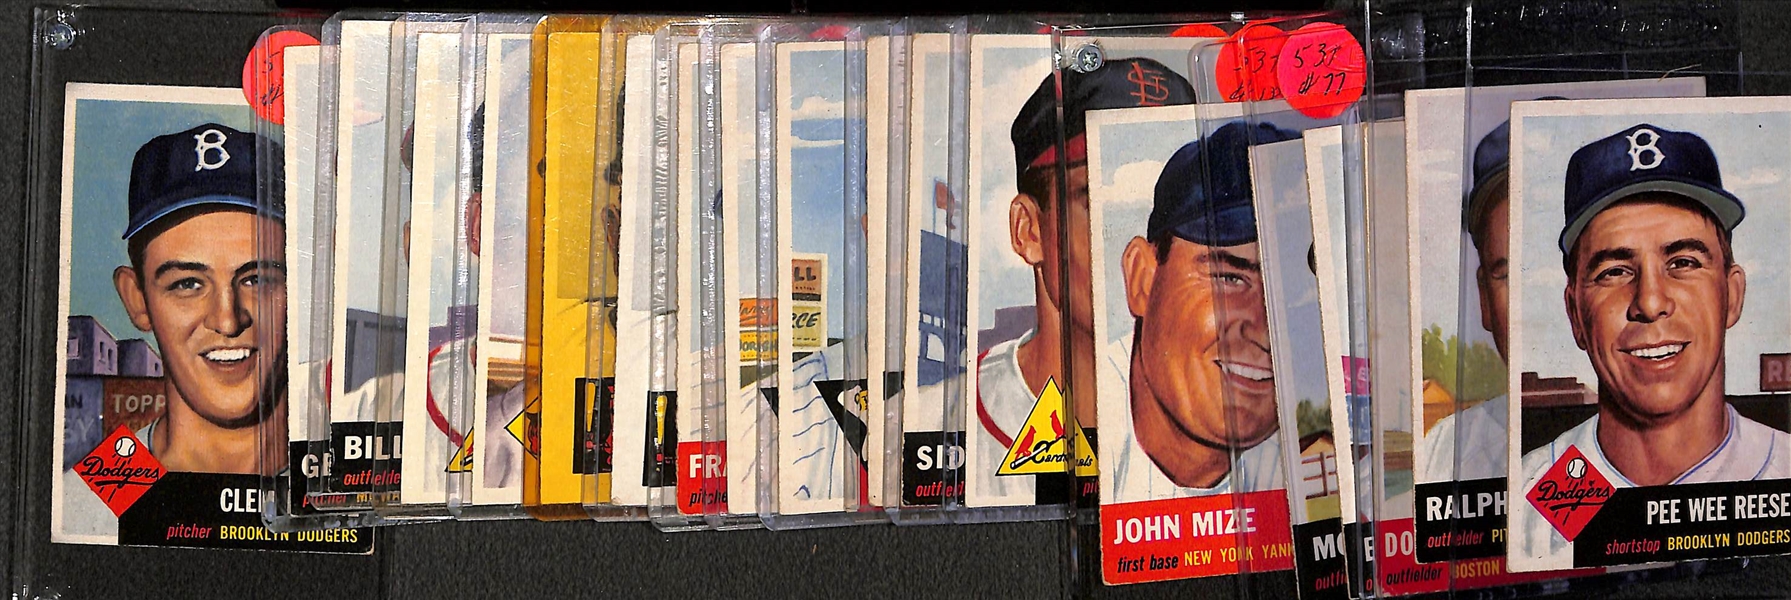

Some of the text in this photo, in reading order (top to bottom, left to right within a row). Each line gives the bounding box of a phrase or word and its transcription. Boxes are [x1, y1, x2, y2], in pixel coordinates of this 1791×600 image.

[194, 129, 230, 172] B
[1626, 128, 1665, 171] B
[113, 394, 166, 413] TOPP
[81, 456, 159, 489] Dodgers
[343, 469, 401, 486] outfelde
[1426, 490, 1507, 521] RALPH
[1536, 479, 1611, 512] Dodgers
[1646, 492, 1791, 525] PEE WEE REESE
[167, 523, 212, 540] pitcher
[297, 529, 358, 544] DODGERS
[1114, 508, 1256, 545] JOHN MIZE
[1427, 530, 1484, 548] outfelder
[1384, 531, 1413, 557] DO
[1606, 529, 1791, 555] shortstop BROOKLYN DODGERS
[1117, 555, 1145, 574] first
[1150, 554, 1178, 571] base
[1184, 550, 1212, 567] NEW
[1386, 566, 1443, 586] outfielder
